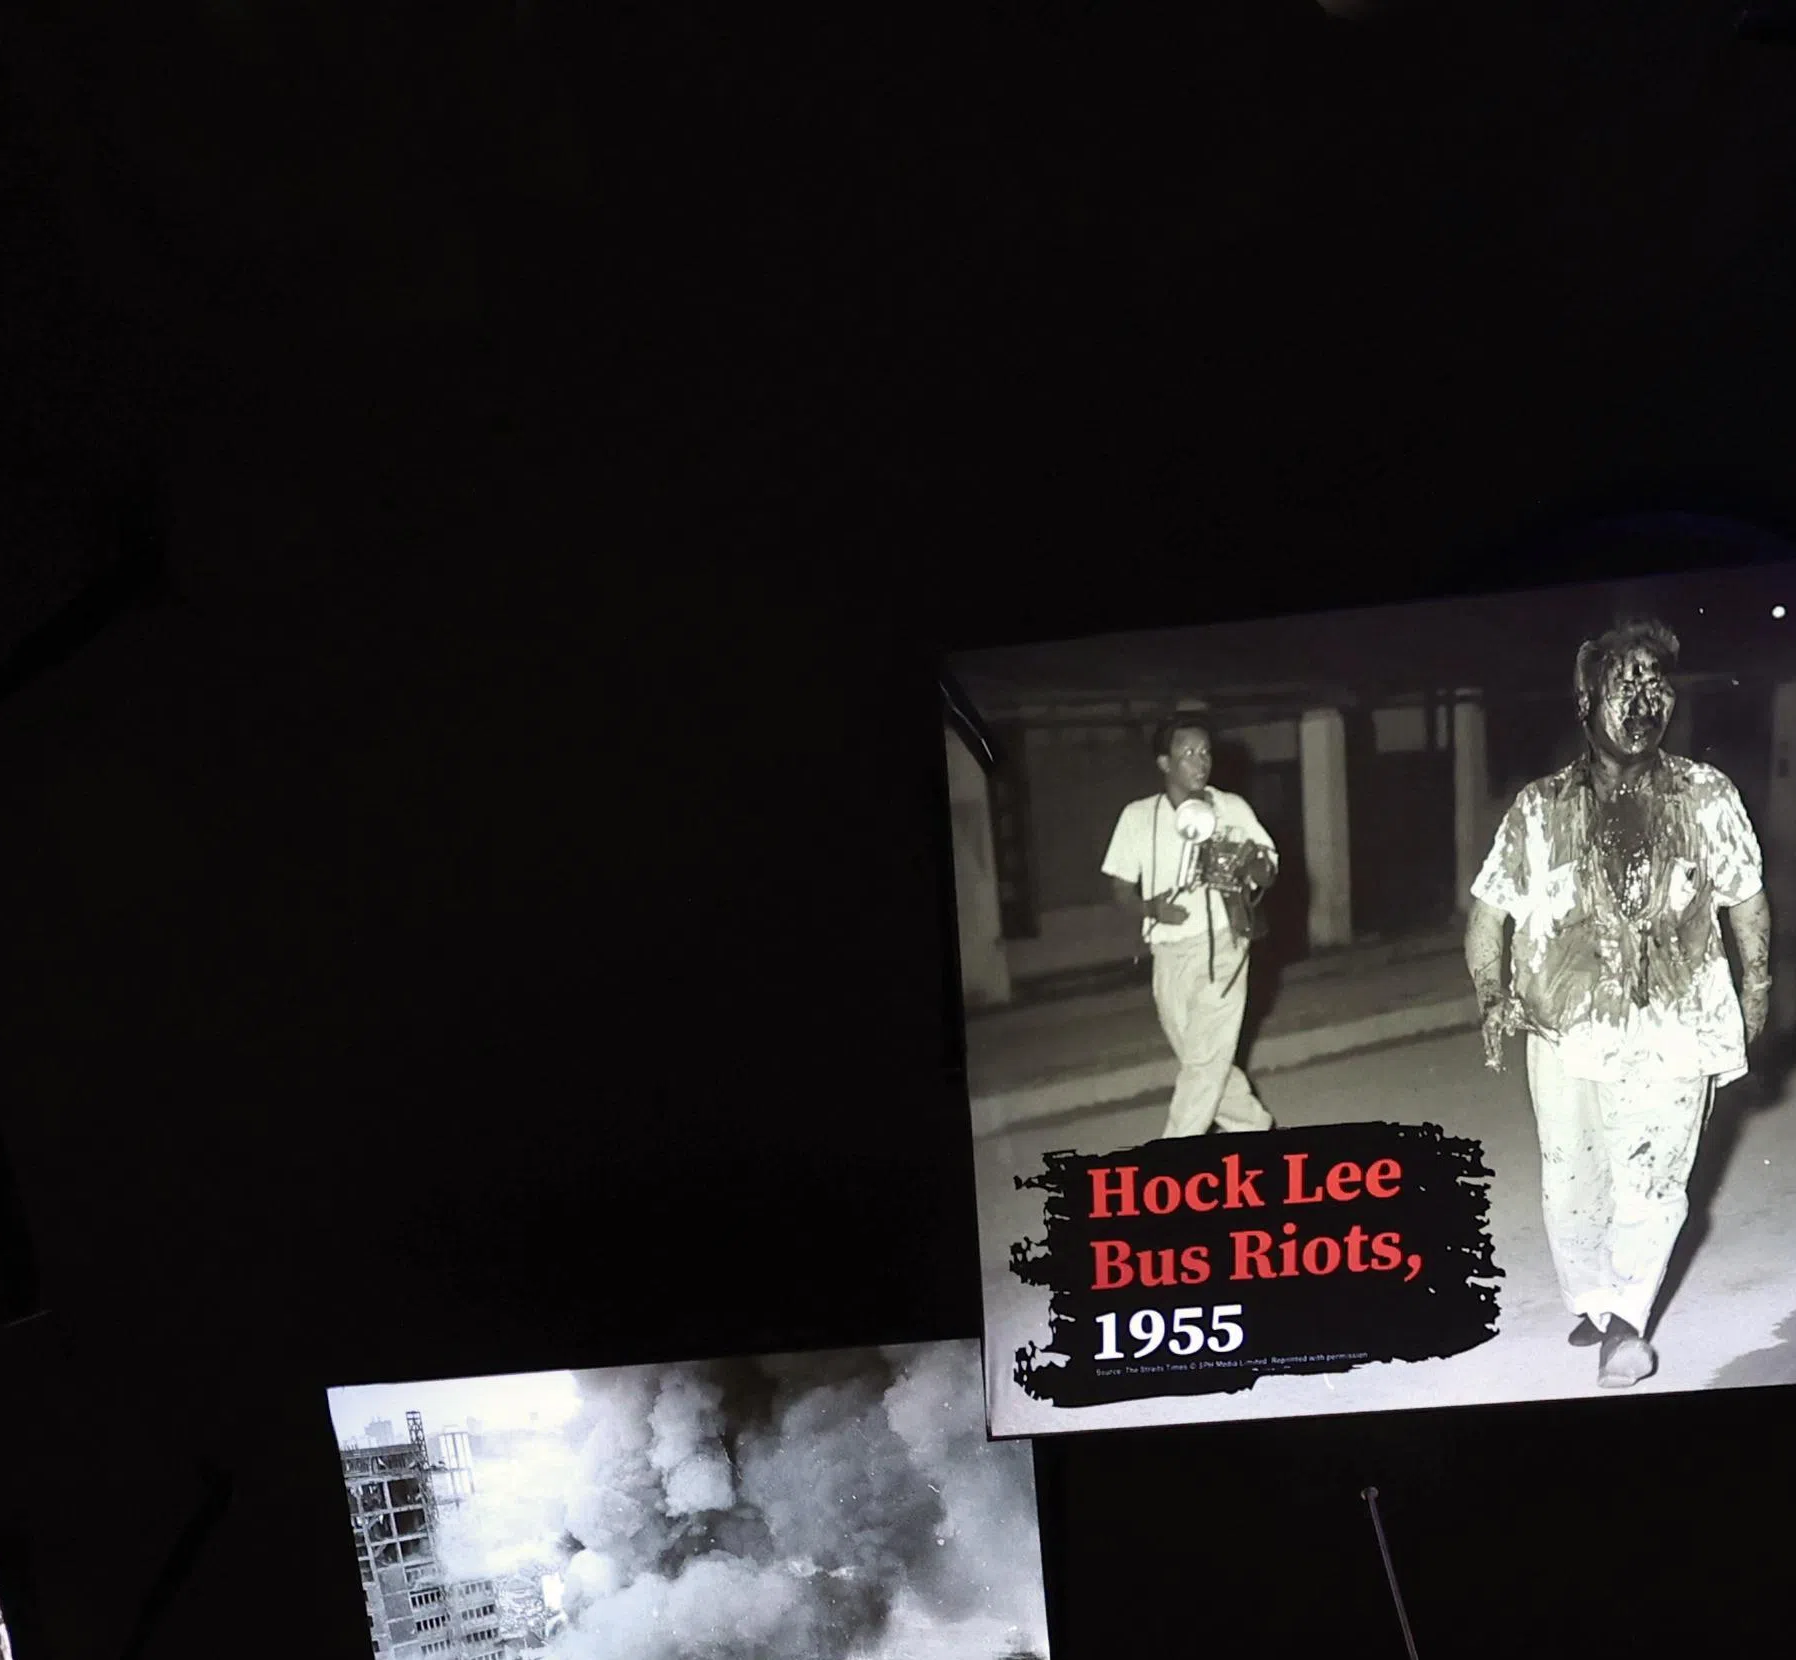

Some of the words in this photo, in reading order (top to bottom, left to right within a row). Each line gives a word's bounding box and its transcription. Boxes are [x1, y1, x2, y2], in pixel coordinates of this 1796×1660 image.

[1087, 1152, 1265, 1219] Hock
[1283, 1152, 1402, 1205] Lee
[1090, 1239, 1211, 1290] Bus
[1229, 1222, 1423, 1282] Riots,
[1093, 1304, 1244, 1361] 1955
